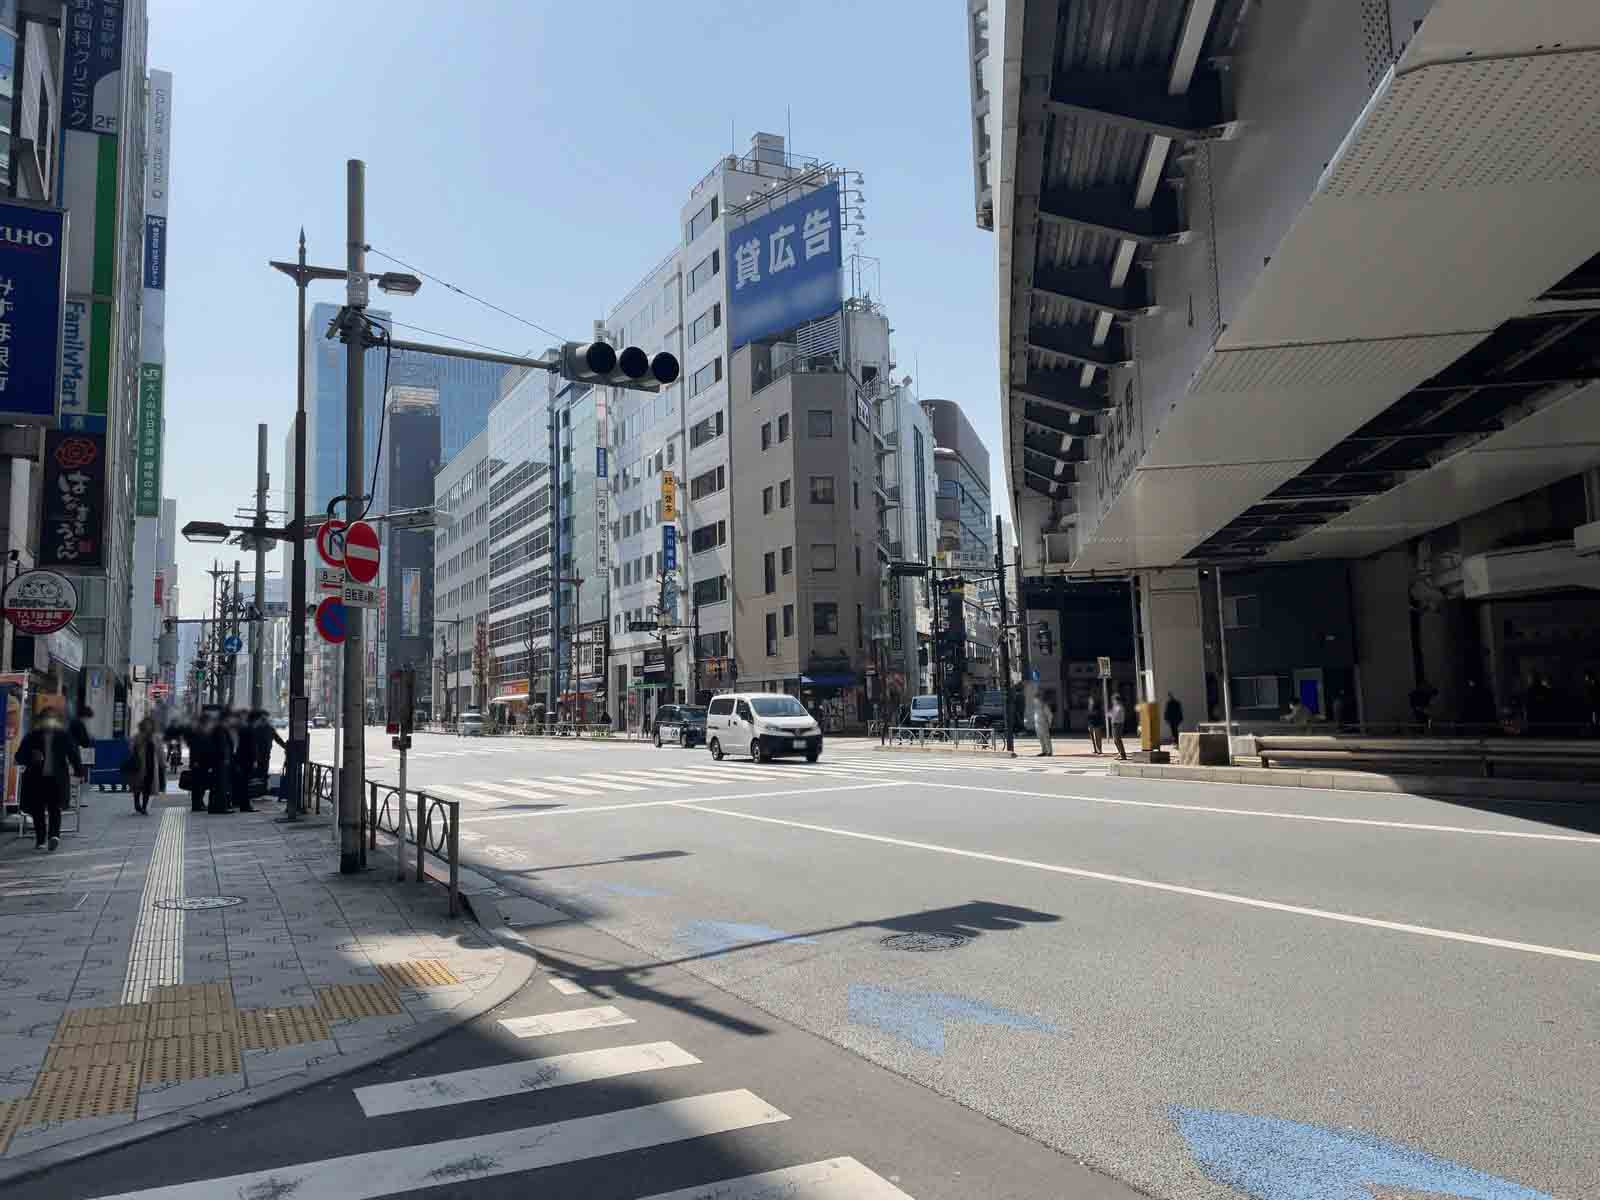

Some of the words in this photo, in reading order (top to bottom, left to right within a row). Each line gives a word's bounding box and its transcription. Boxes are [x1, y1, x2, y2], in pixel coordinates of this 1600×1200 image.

[94, 115, 116, 129] 2F
[734, 207, 832, 290] 貸広告
[61, 302, 86, 407] FamilyMart
